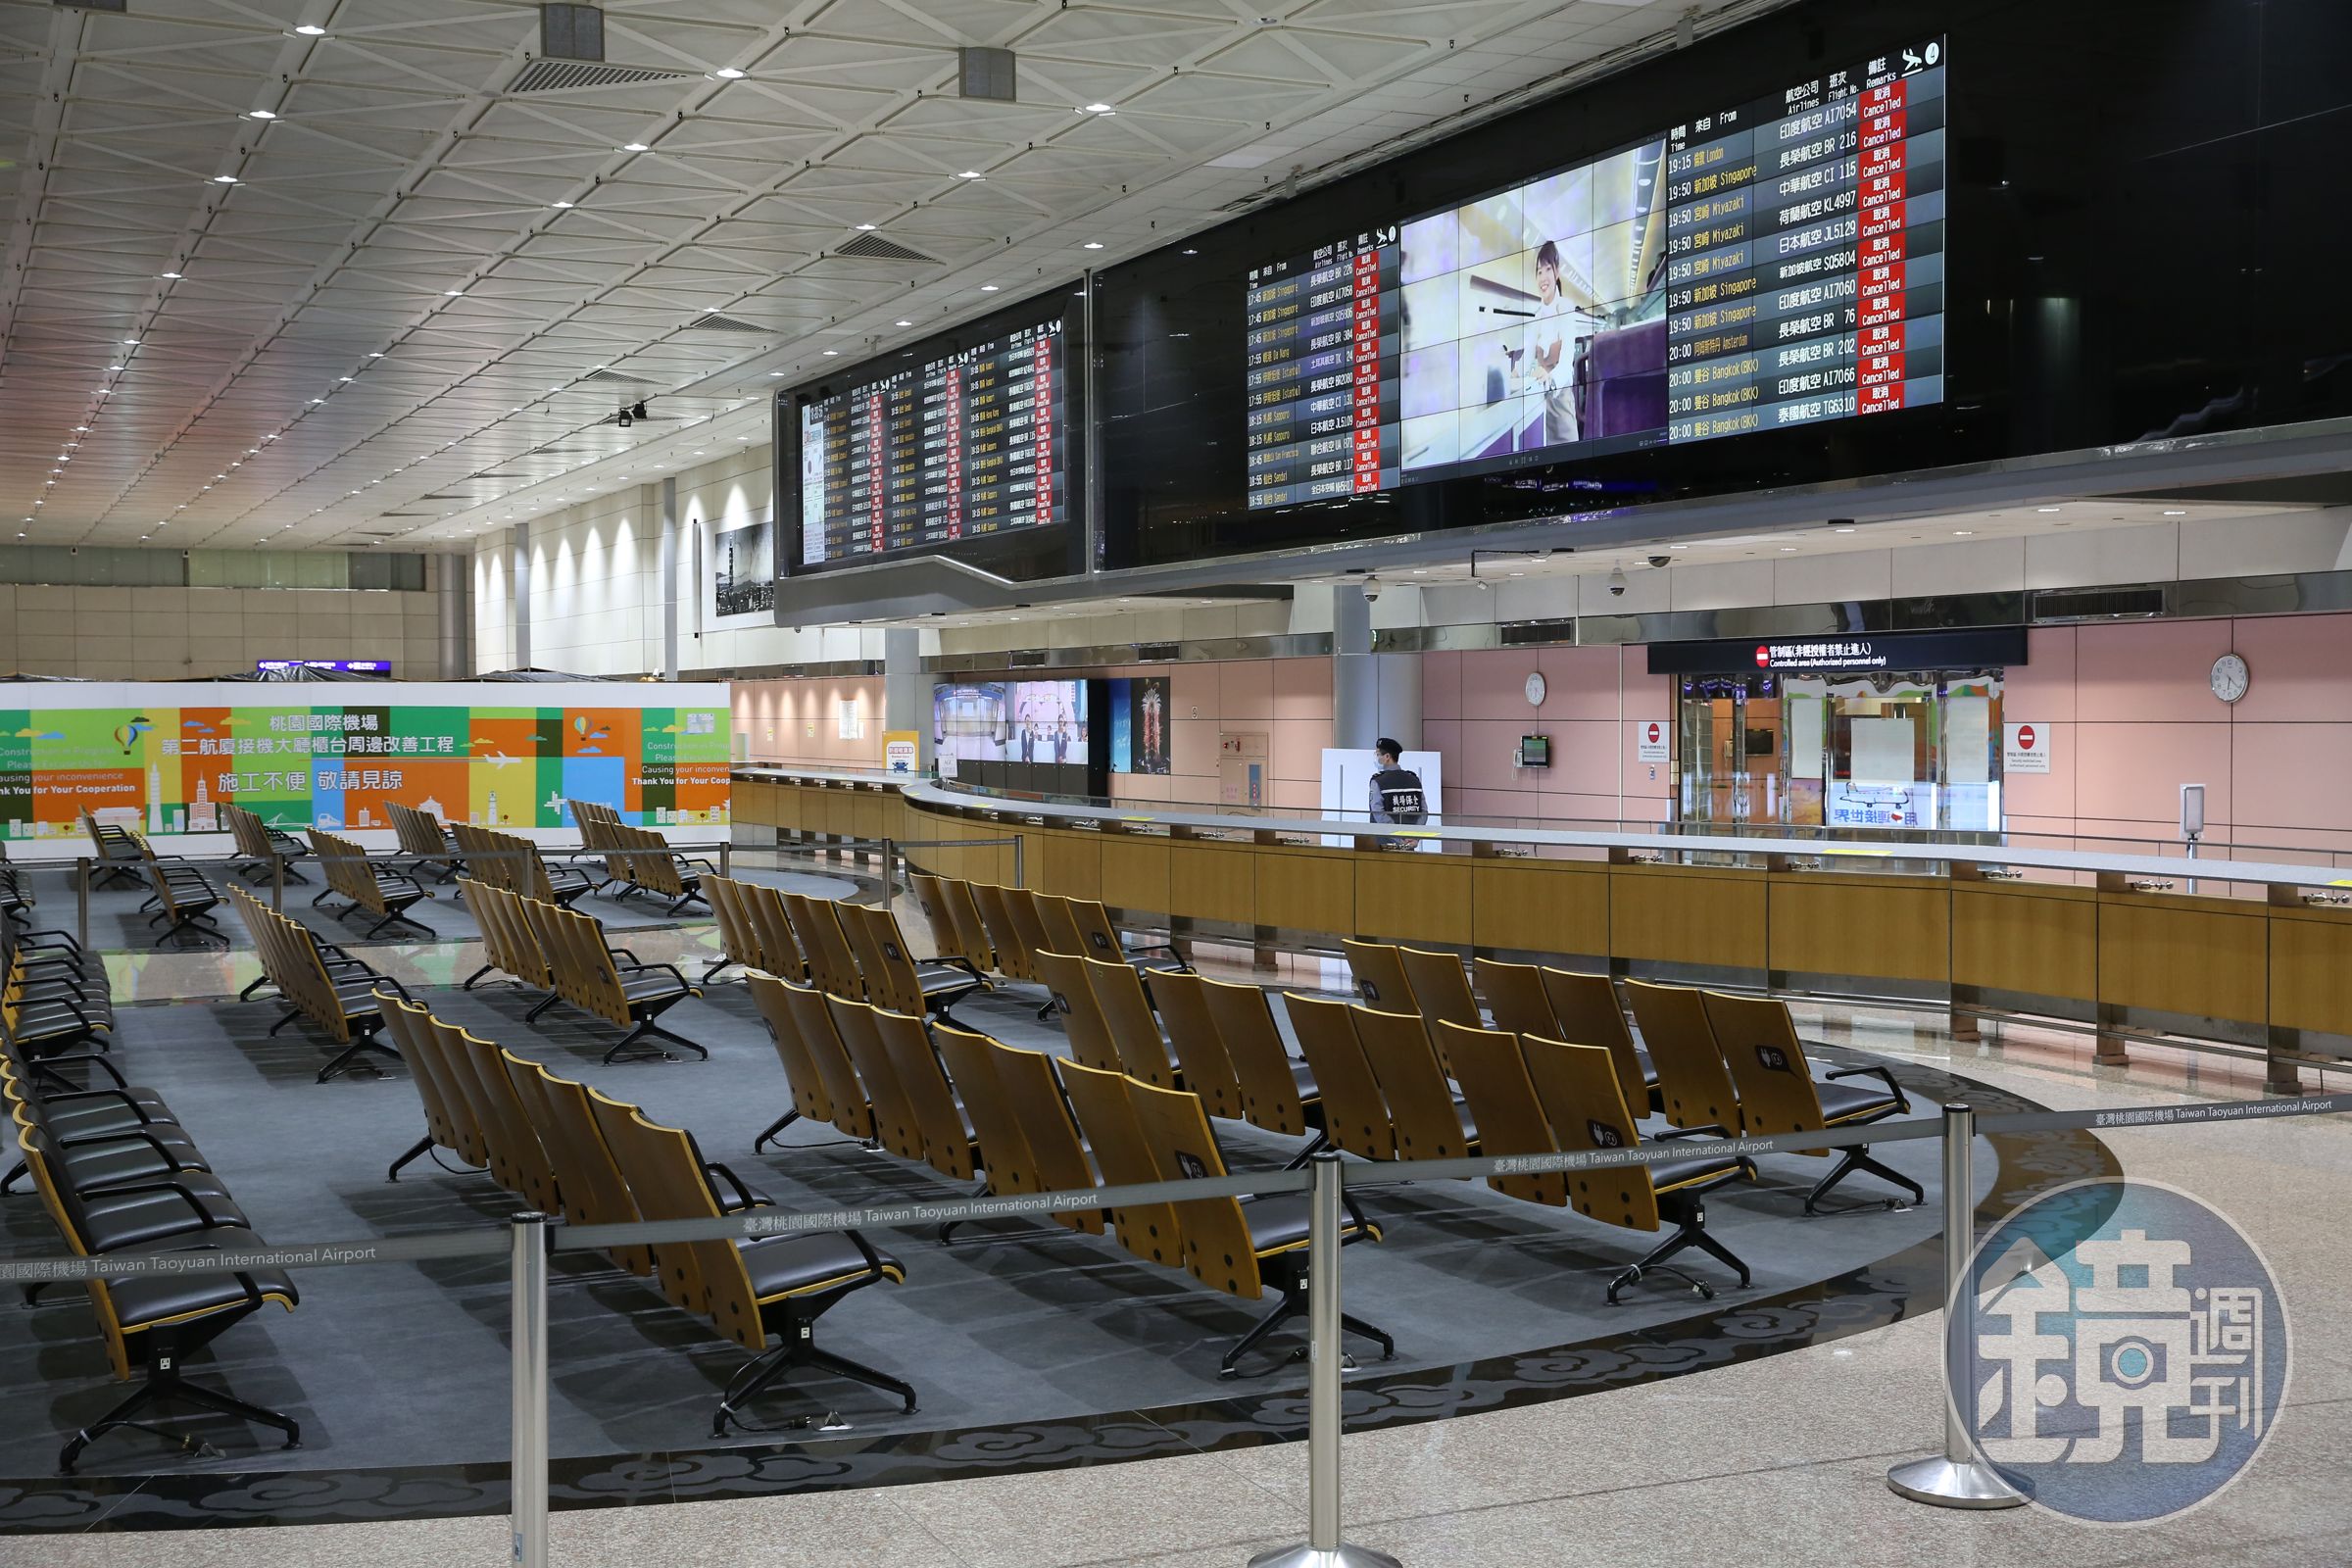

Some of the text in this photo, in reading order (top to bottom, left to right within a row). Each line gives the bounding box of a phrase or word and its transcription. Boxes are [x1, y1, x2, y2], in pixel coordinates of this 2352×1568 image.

[1868, 58, 1886, 75] 備註
[1829, 72, 1847, 88] 班次
[1866, 73, 1896, 90] Remarks
[1785, 81, 1819, 104] 航空公司
[1828, 85, 1859, 102] Flight No.
[1874, 85, 1890, 102] 取消
[1788, 98, 1820, 116] Airlines
[1863, 99, 1901, 118] Cancelled
[1670, 124, 1686, 141] 時間
[1719, 110, 1737, 125] From
[1874, 115, 1890, 132] 取消
[1668, 156, 1691, 174] 19:15
[1779, 114, 1822, 140] 印度航空
[1824, 102, 1857, 124] AI7054
[1863, 128, 1901, 147] Cancelled
[1670, 141, 1686, 153] Time
[1873, 147, 1890, 163] 取消
[1668, 132, 1857, 201] 19:50 新加坡 Singapore 長榮航空 BR 216
[1863, 157, 1901, 177] Cancelled
[1873, 176, 1890, 193] 取消
[1668, 210, 1691, 228] 19:50
[1713, 196, 1744, 217] Miyazaki
[1779, 172, 1822, 197] 中華航空
[1839, 161, 1857, 179] 115
[1862, 188, 1900, 207] Cancelled
[1668, 238, 1691, 254] 19:50
[1713, 223, 1744, 245] Miyazaki
[1779, 201, 1822, 226] 荷蘭航空
[1824, 191, 1857, 212] KL4997
[1873, 207, 1890, 222] 取消
[1862, 219, 1900, 238] Cancelled
[1668, 265, 1691, 281] 19:50
[1713, 250, 1744, 271] Miyazaki
[1779, 229, 1822, 253] 日本航空
[1824, 220, 1857, 242] JL5129
[1873, 238, 1889, 253] 取消
[1862, 249, 1900, 268] Cancelled
[1668, 291, 1691, 308] 19:50
[1694, 283, 1717, 303] 新加坡
[1720, 277, 1757, 297] Singapore
[1824, 250, 1857, 271] SQ5804
[1873, 267, 1889, 281] 取消
[1862, 278, 1900, 296] Cancelled
[1668, 279, 1856, 334] 19:50 新加坡 Singapore 印度航空 AI7060
[1873, 296, 1889, 311] 取消
[1862, 309, 1900, 328] Cancelled
[1668, 345, 1691, 361] 20:00
[1779, 316, 1822, 339] 長榮航空
[1823, 314, 1834, 328] BR
[1844, 308, 1856, 324] 76
[1872, 326, 1889, 341] 取消
[1862, 339, 1900, 357] Cancelled
[1668, 372, 1691, 388] 20:00
[1694, 368, 1710, 385] 曼谷
[1779, 344, 1822, 368] 長榮航空
[1823, 343, 1834, 357] BR
[1838, 338, 1855, 355] 202
[1872, 356, 1889, 369] 取消
[1862, 368, 1900, 386] Cancelled
[1668, 397, 1691, 413] 20:00
[1694, 394, 1710, 410] 曼谷
[1779, 373, 1822, 395] 印度航空
[1823, 368, 1855, 389] AI7066
[1872, 386, 1889, 399] 取消
[1862, 398, 1900, 415] Cancelled
[1311, 419, 1334, 435] 日本航空
[1668, 424, 1691, 441] 20:00
[1694, 421, 1710, 438] 曼谷
[1779, 402, 1822, 423] 泰國航空
[1823, 396, 1855, 416] TG6310
[1770, 658, 1798, 667] Controlled
[1811, 658, 1842, 667] (Authorized
[1843, 657, 1871, 667] personnel
[1872, 656, 1886, 666] only)
[270, 714, 378, 732] 桃園國際機場
[33, 774, 53, 783] your
[56, 772, 124, 781] inconvenience
[642, 764, 730, 775] Causing your inconven
[33, 786, 48, 794] for
[50, 785, 73, 794] Your
[75, 784, 136, 794] Cooperation
[218, 769, 403, 793] 施工不便 敬請見諒
[632, 777, 658, 785] Thank
[710, 777, 731, 785] Coop
[2095, 1099, 2332, 1127] 臺灣桃園國際機場 Taiwan Taoyuan International Airport
[1494, 1139, 1774, 1174] 臺灣桃園國際機場 Taiwan Taoyuan International Airport
[742, 1193, 1098, 1234] 臺灣桃園國際機場 Taiwan Taoyuan International Airport
[91, 1256, 146, 1274] Taiwan
[149, 1253, 216, 1274] Taoyuan
[220, 1248, 318, 1268] International
[321, 1245, 376, 1266] Airport
